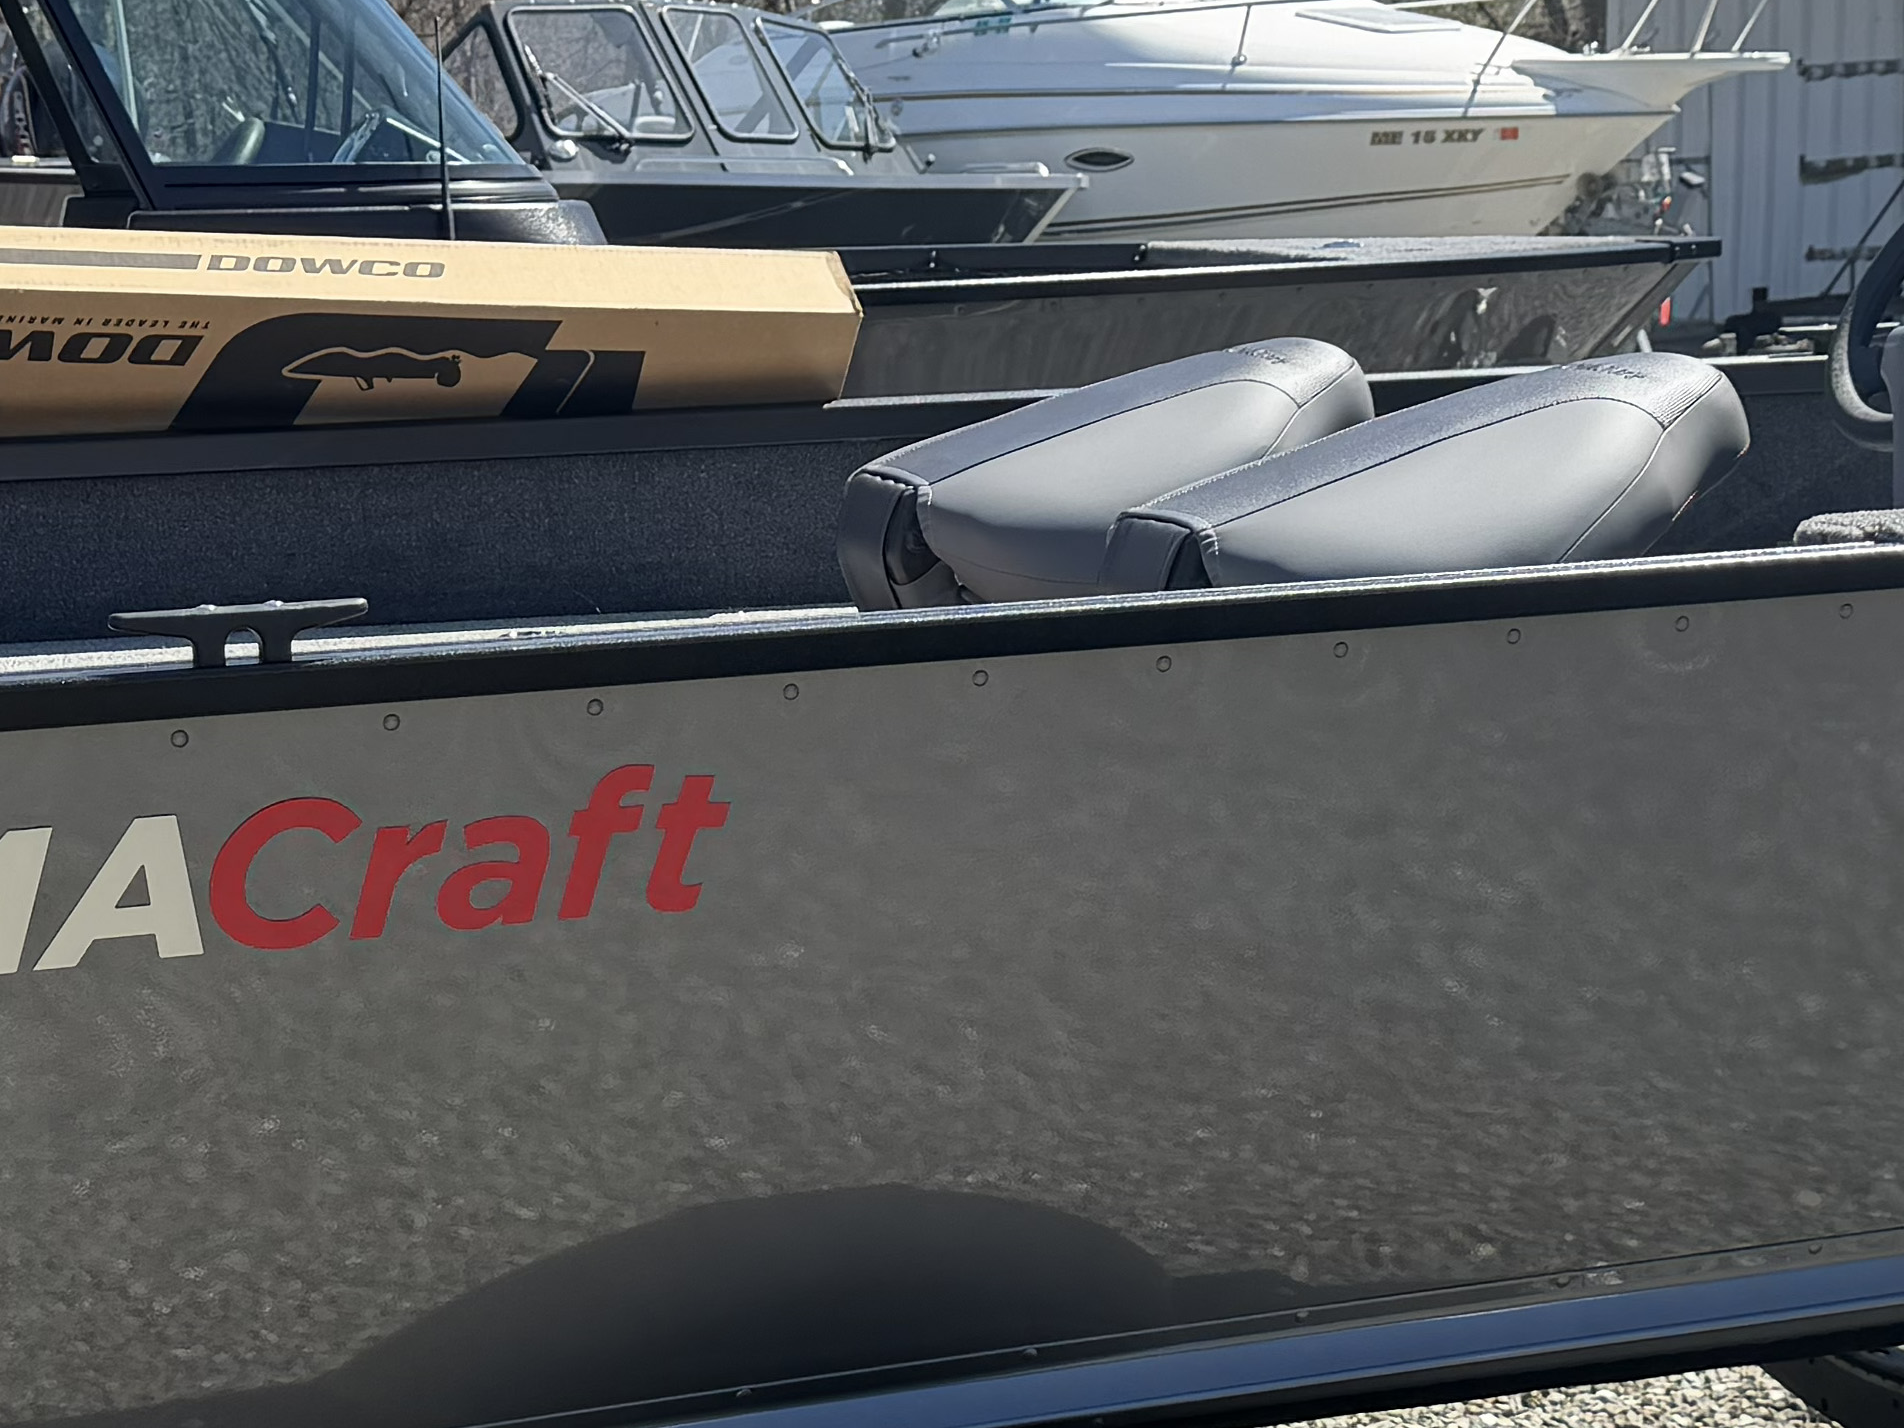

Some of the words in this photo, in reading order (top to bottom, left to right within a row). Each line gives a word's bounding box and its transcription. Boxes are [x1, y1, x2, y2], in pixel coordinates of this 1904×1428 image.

[207, 254, 446, 279] DOWCO
[73, 316, 93, 326] IN
[102, 317, 168, 328] LEADER
[179, 319, 212, 330] THE
